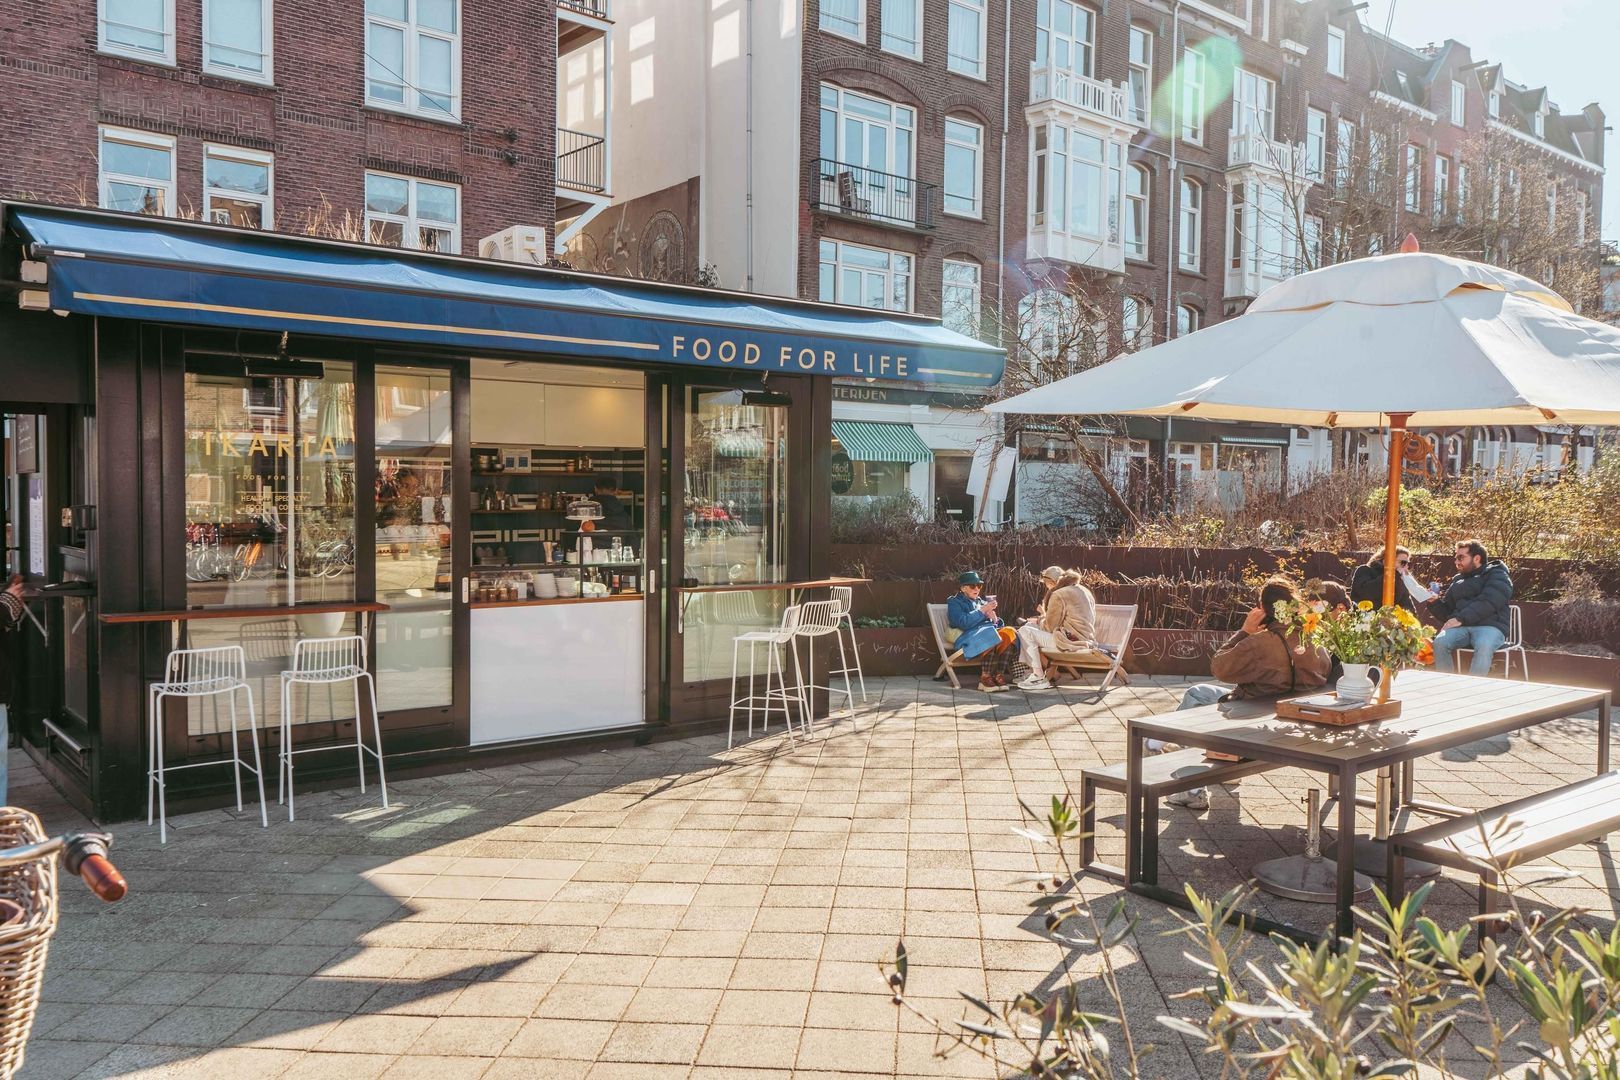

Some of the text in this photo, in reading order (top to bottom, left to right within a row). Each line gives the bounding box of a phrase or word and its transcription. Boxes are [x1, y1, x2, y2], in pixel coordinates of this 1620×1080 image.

[672, 335, 908, 377] FOOD FOR LIFE
[831, 387, 887, 400] TERIJEN
[204, 431, 338, 458] IKARIA
